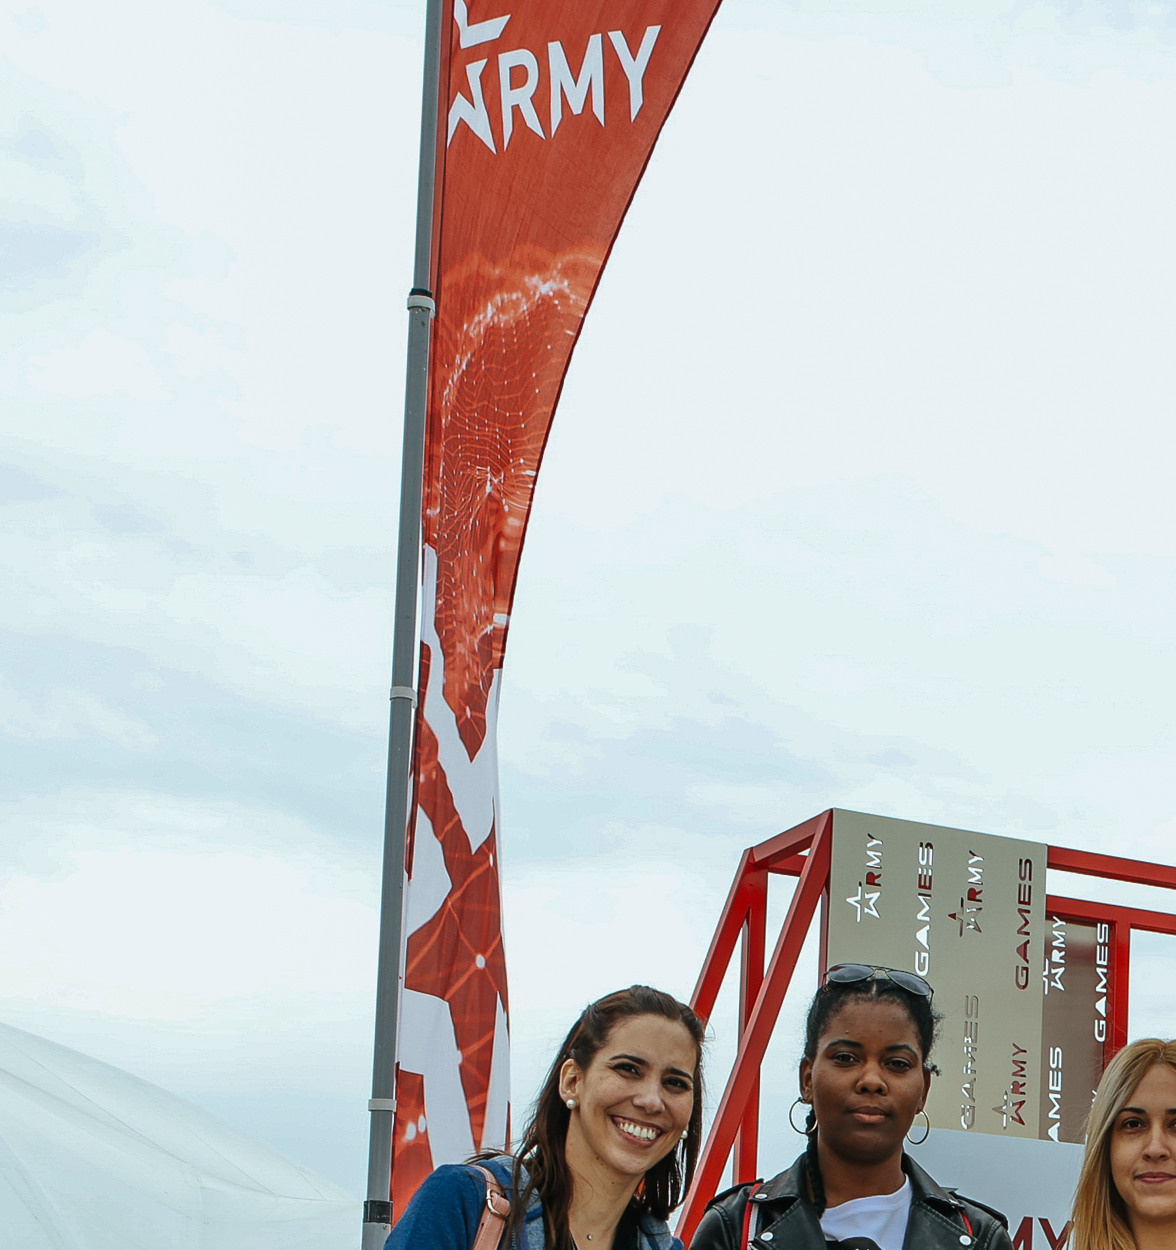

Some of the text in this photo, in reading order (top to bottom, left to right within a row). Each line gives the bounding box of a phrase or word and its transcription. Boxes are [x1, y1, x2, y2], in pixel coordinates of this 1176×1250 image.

[446, 0, 662, 155] ARMY
[915, 841, 934, 977] GAMES
[1015, 857, 1033, 990] GAMES
[1094, 922, 1109, 1043] GAMES
[960, 994, 979, 1130] GAMES
[1047, 1046, 1063, 1143] AMES
